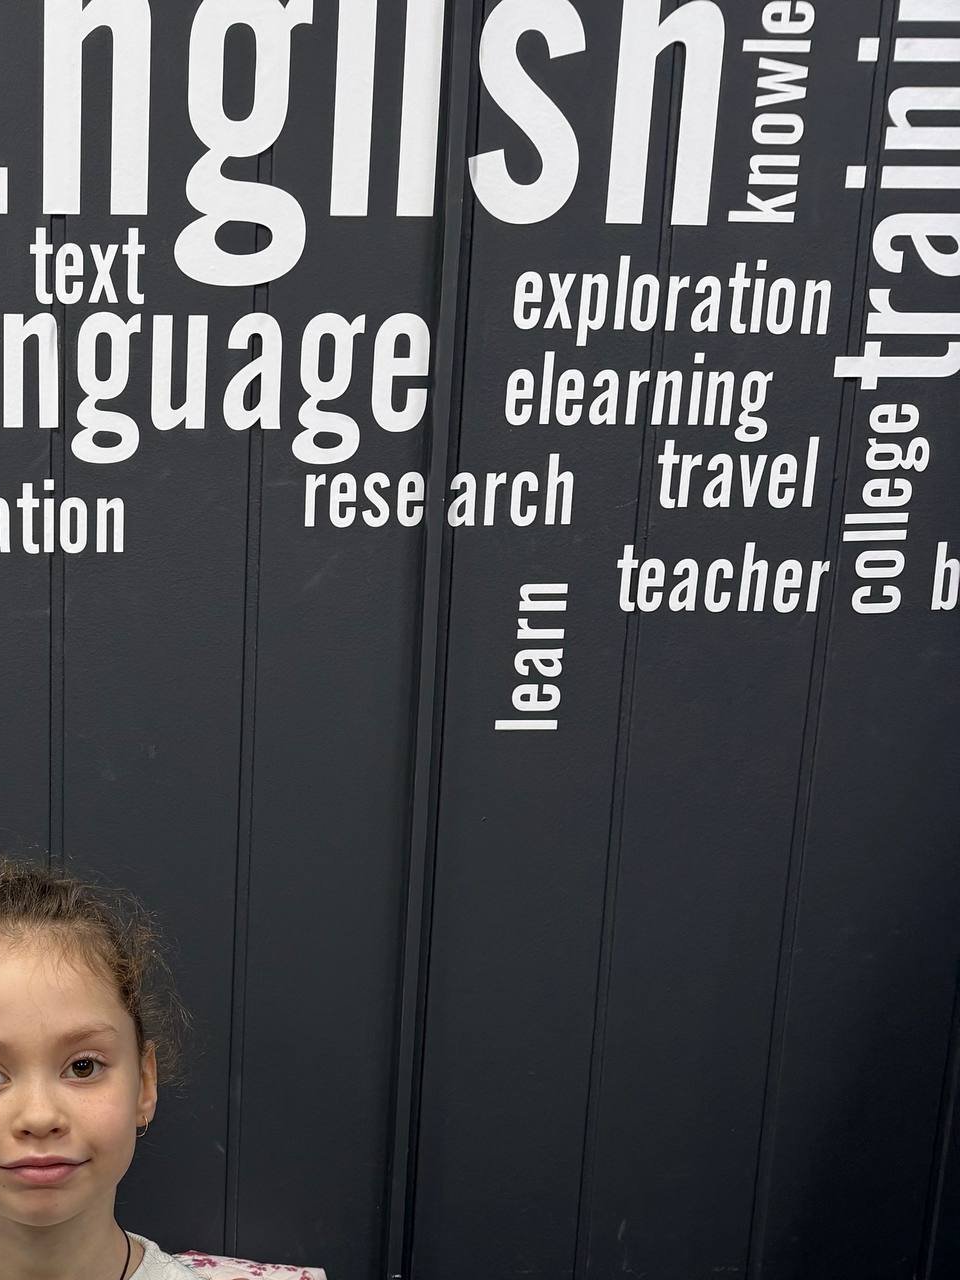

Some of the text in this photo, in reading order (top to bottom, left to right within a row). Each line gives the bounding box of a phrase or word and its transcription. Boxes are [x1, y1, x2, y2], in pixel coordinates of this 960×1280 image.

[30, 227, 145, 305] text
[514, 255, 832, 346] exploration
[505, 351, 773, 442] elearning
[658, 437, 819, 508] travel
[843, 404, 929, 613] college
[617, 542, 830, 613] teacher
[495, 584, 569, 731] learn
